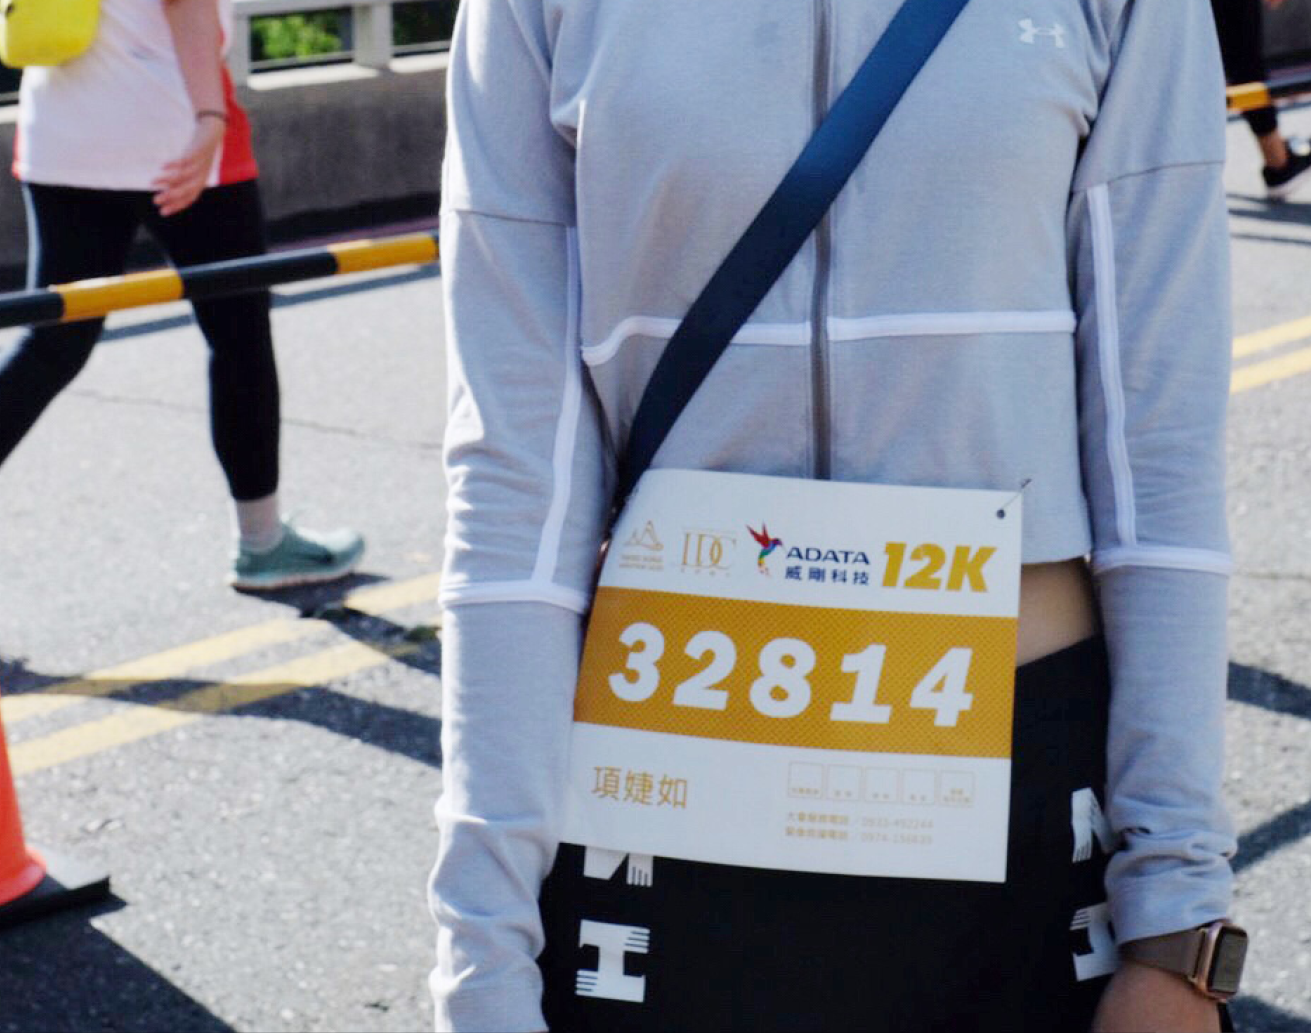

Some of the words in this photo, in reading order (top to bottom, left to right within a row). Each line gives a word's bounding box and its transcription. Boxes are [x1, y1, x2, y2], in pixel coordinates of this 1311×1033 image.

[785, 565, 869, 585] 威剛科技
[786, 546, 871, 566] ADATA
[881, 541, 997, 593] 12K
[608, 621, 973, 727] 32814
[591, 765, 688, 809] 項婕如
